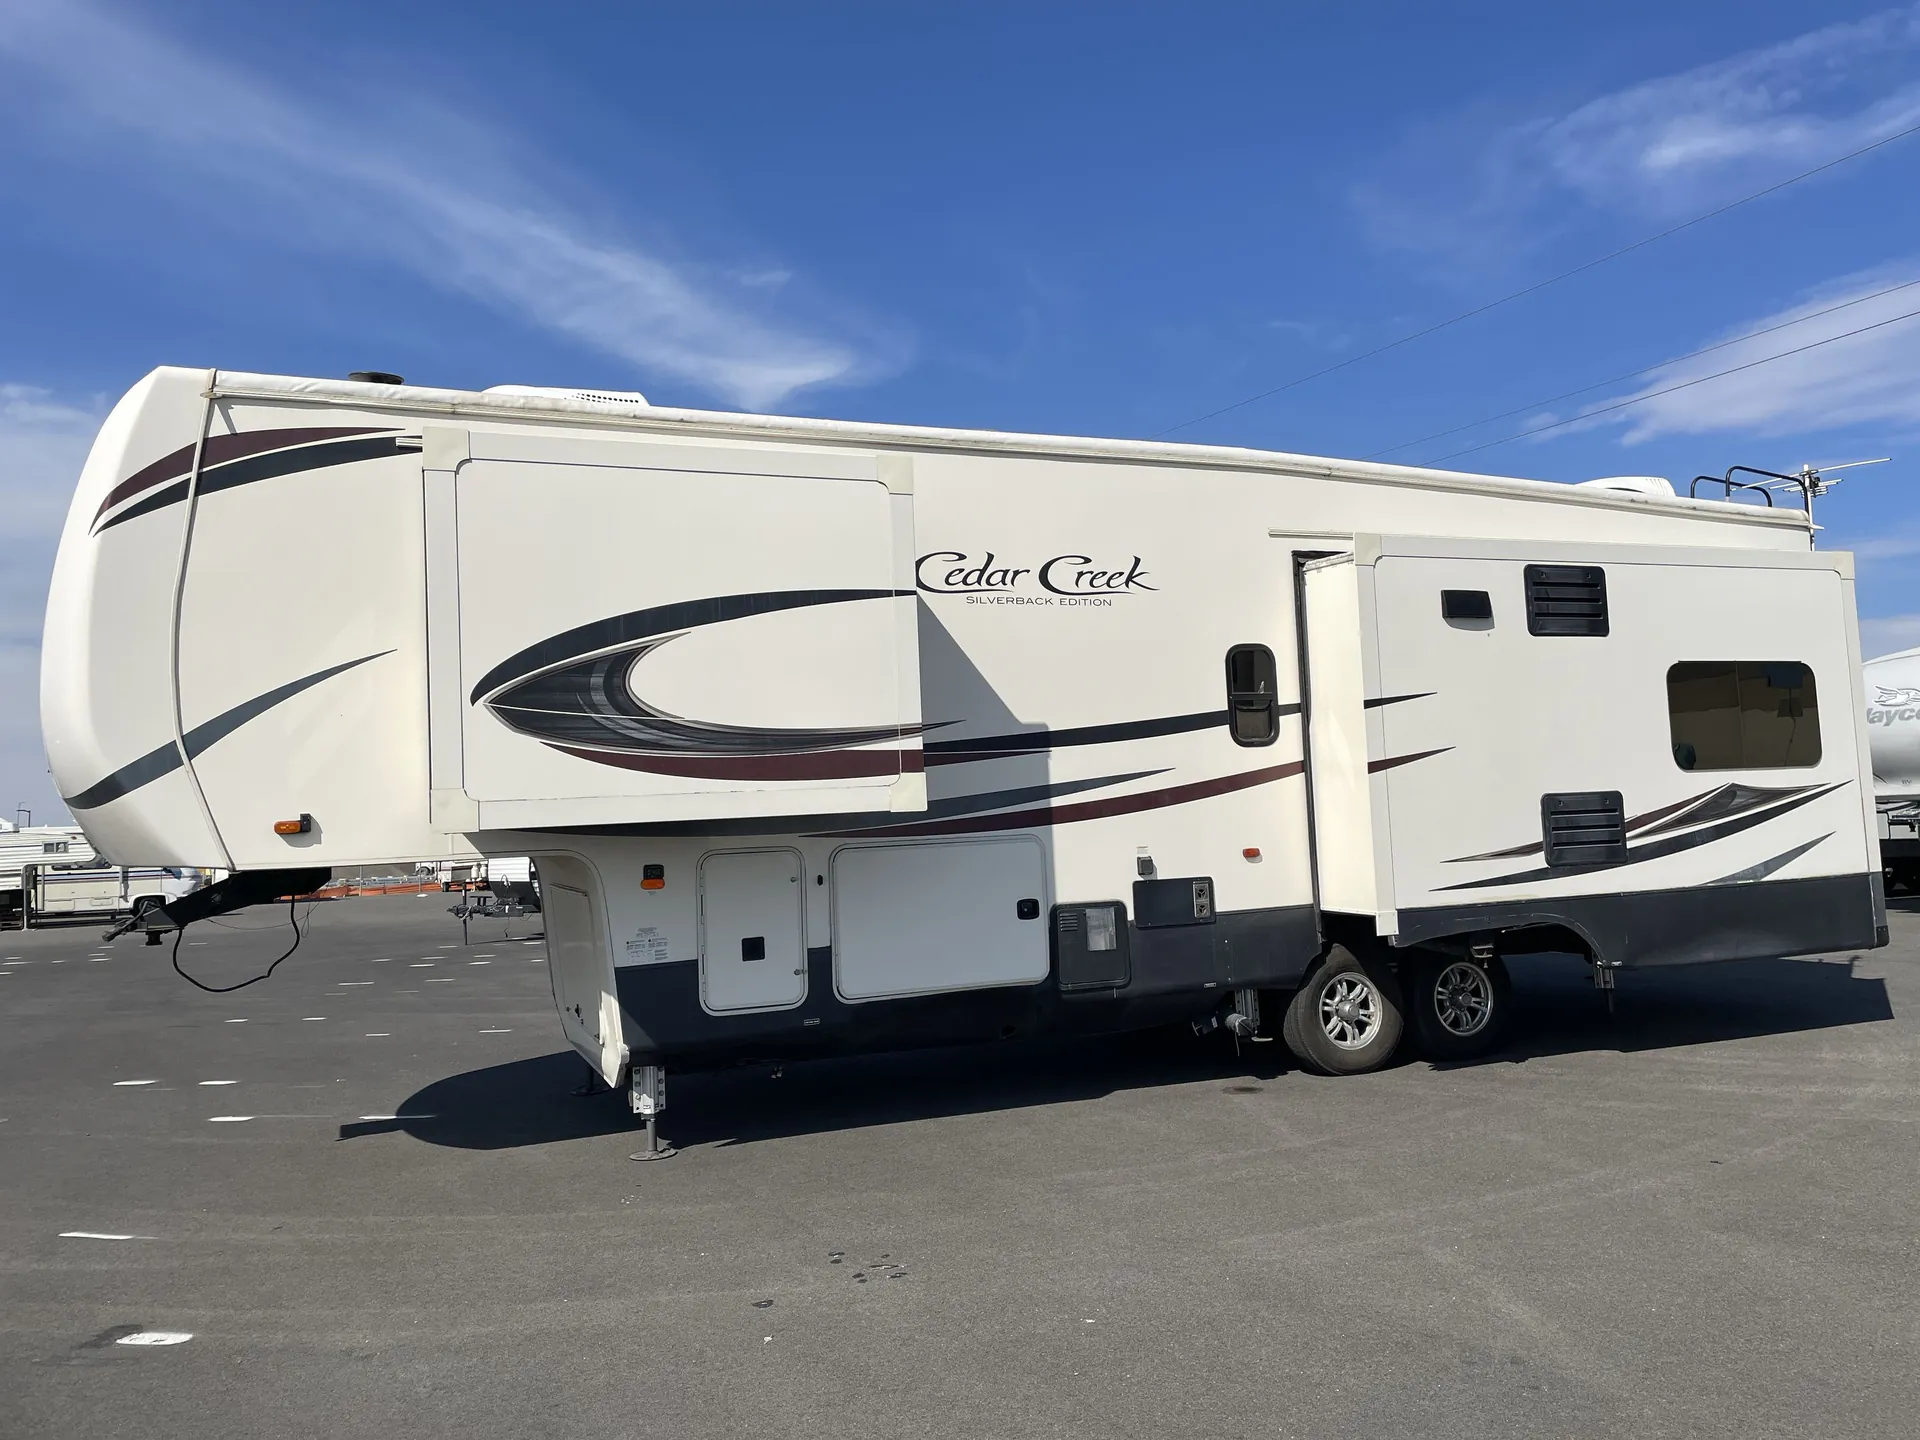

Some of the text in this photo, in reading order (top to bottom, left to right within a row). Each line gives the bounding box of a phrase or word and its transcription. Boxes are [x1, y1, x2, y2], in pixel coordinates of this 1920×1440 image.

[915, 551, 1160, 596] Cedar Creek
[966, 596, 1112, 606] SILVERBACK EDITION
[1866, 708, 1920, 726] ayc
